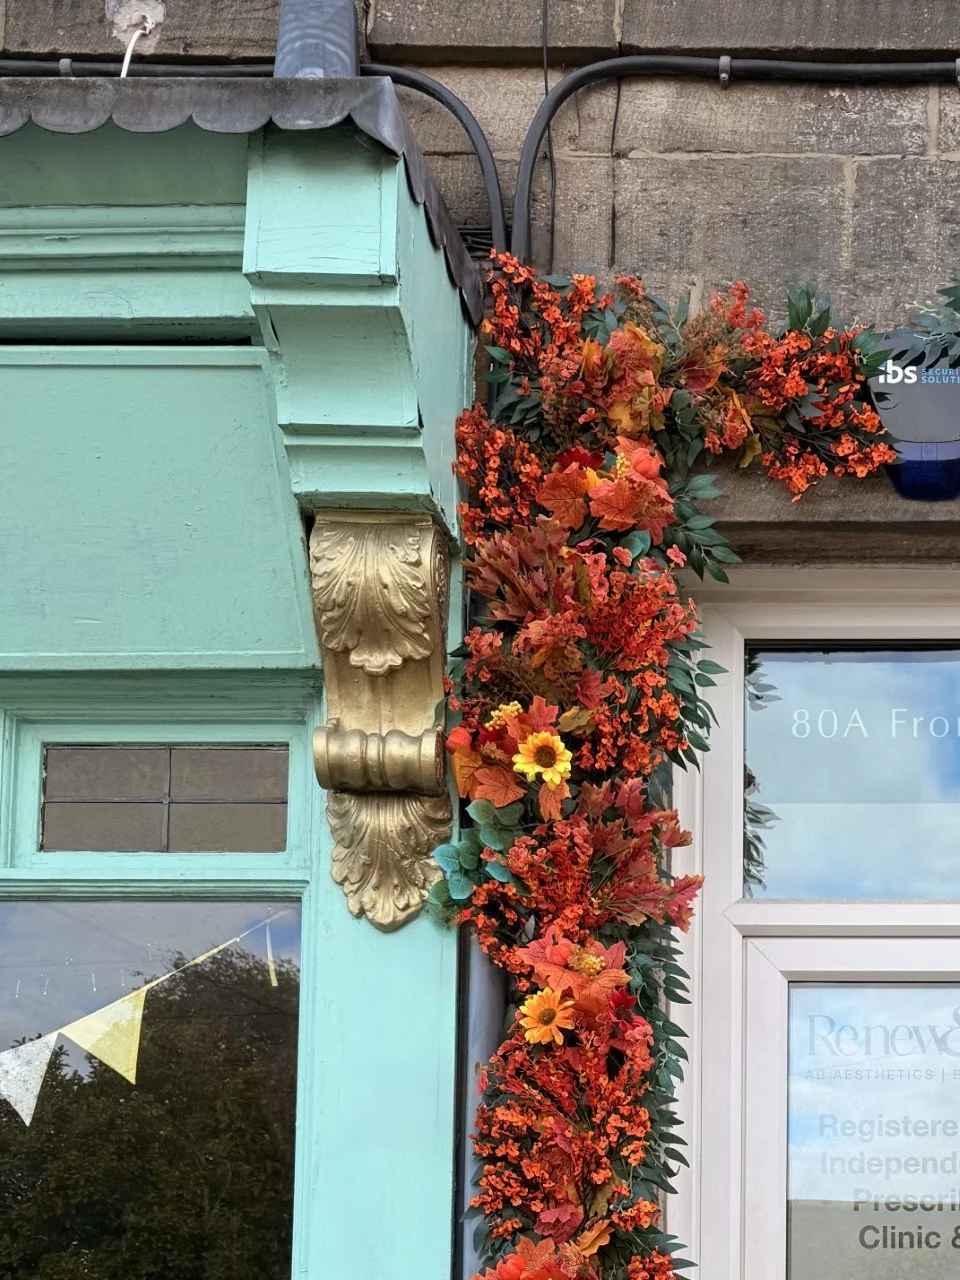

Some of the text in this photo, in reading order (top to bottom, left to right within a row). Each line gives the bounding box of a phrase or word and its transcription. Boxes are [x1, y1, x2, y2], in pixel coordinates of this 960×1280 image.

[878, 359, 918, 384] ibs
[791, 708, 869, 739] 80A
[805, 1069, 825, 1080] AB
[833, 1069, 934, 1080] AESTHETICS
[858, 1225, 941, 1249] Clinic
